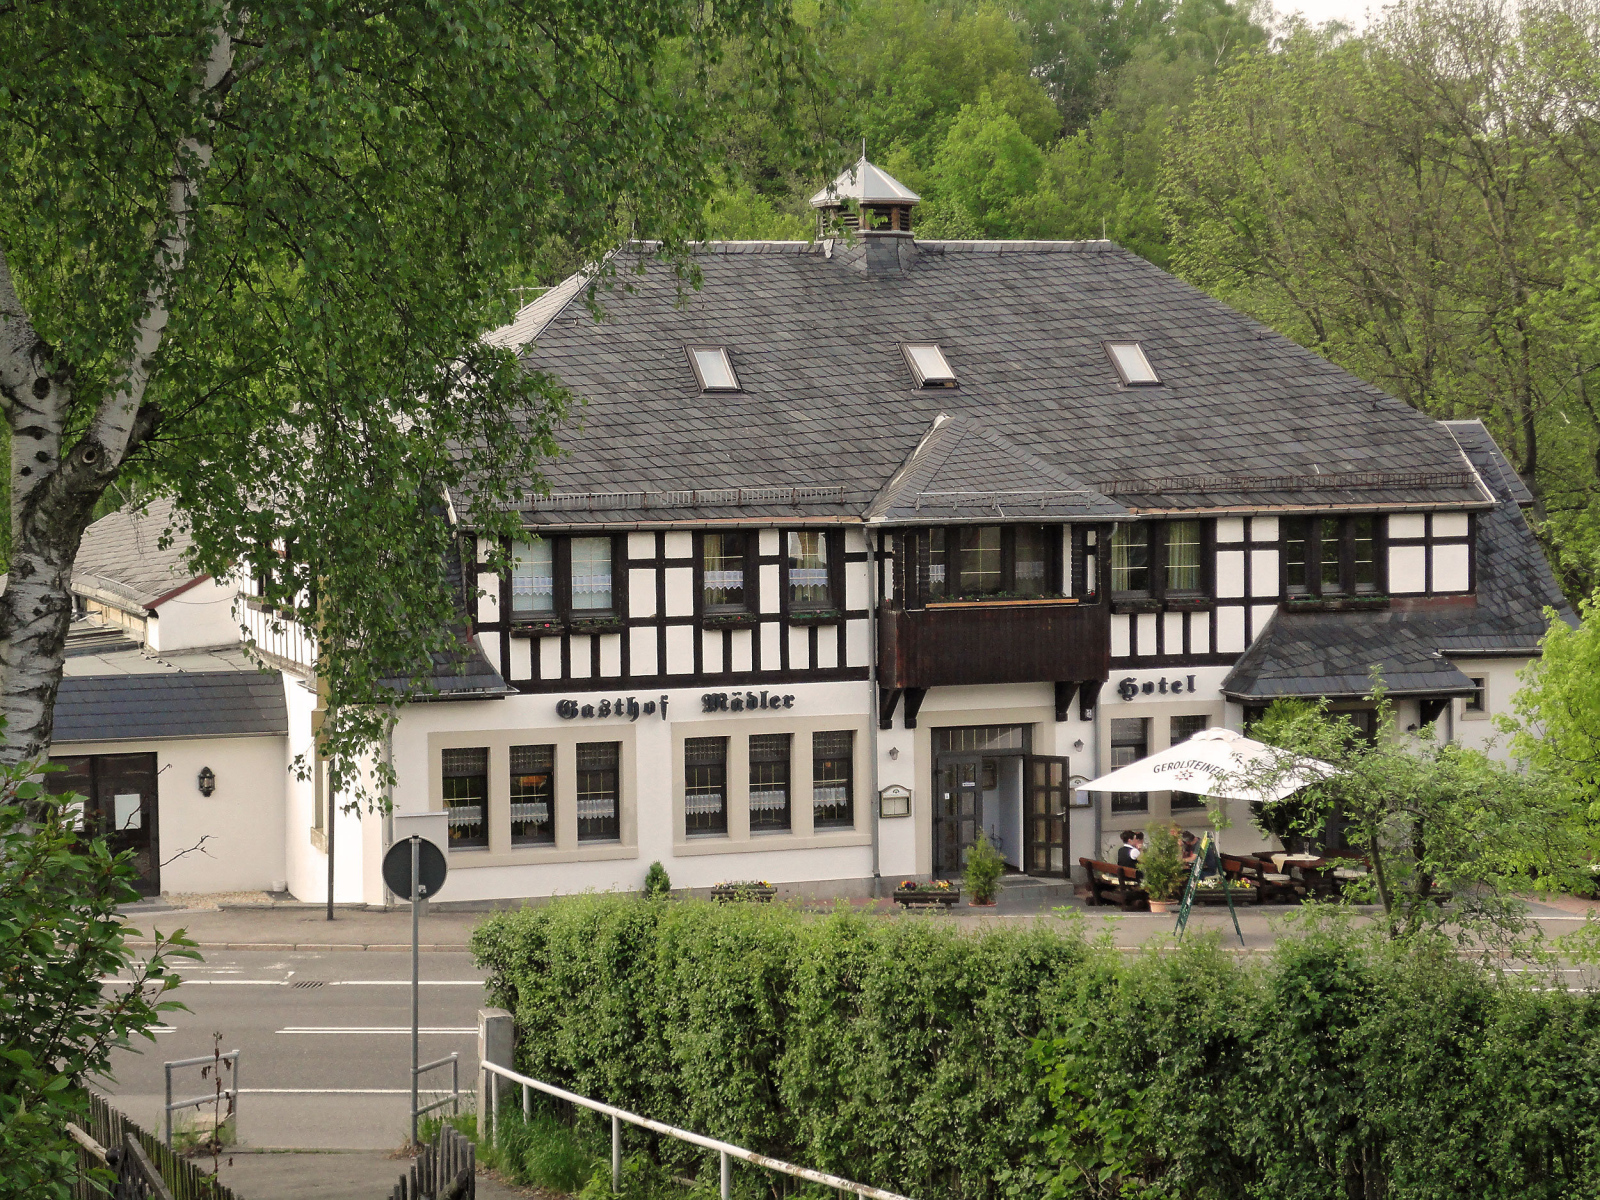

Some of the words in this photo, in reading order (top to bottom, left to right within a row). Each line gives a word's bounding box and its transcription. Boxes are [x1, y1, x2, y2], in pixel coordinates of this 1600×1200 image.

[1118, 675, 1196, 701] Hotel
[556, 695, 669, 722] Gasthof
[701, 690, 795, 713] Mädler
